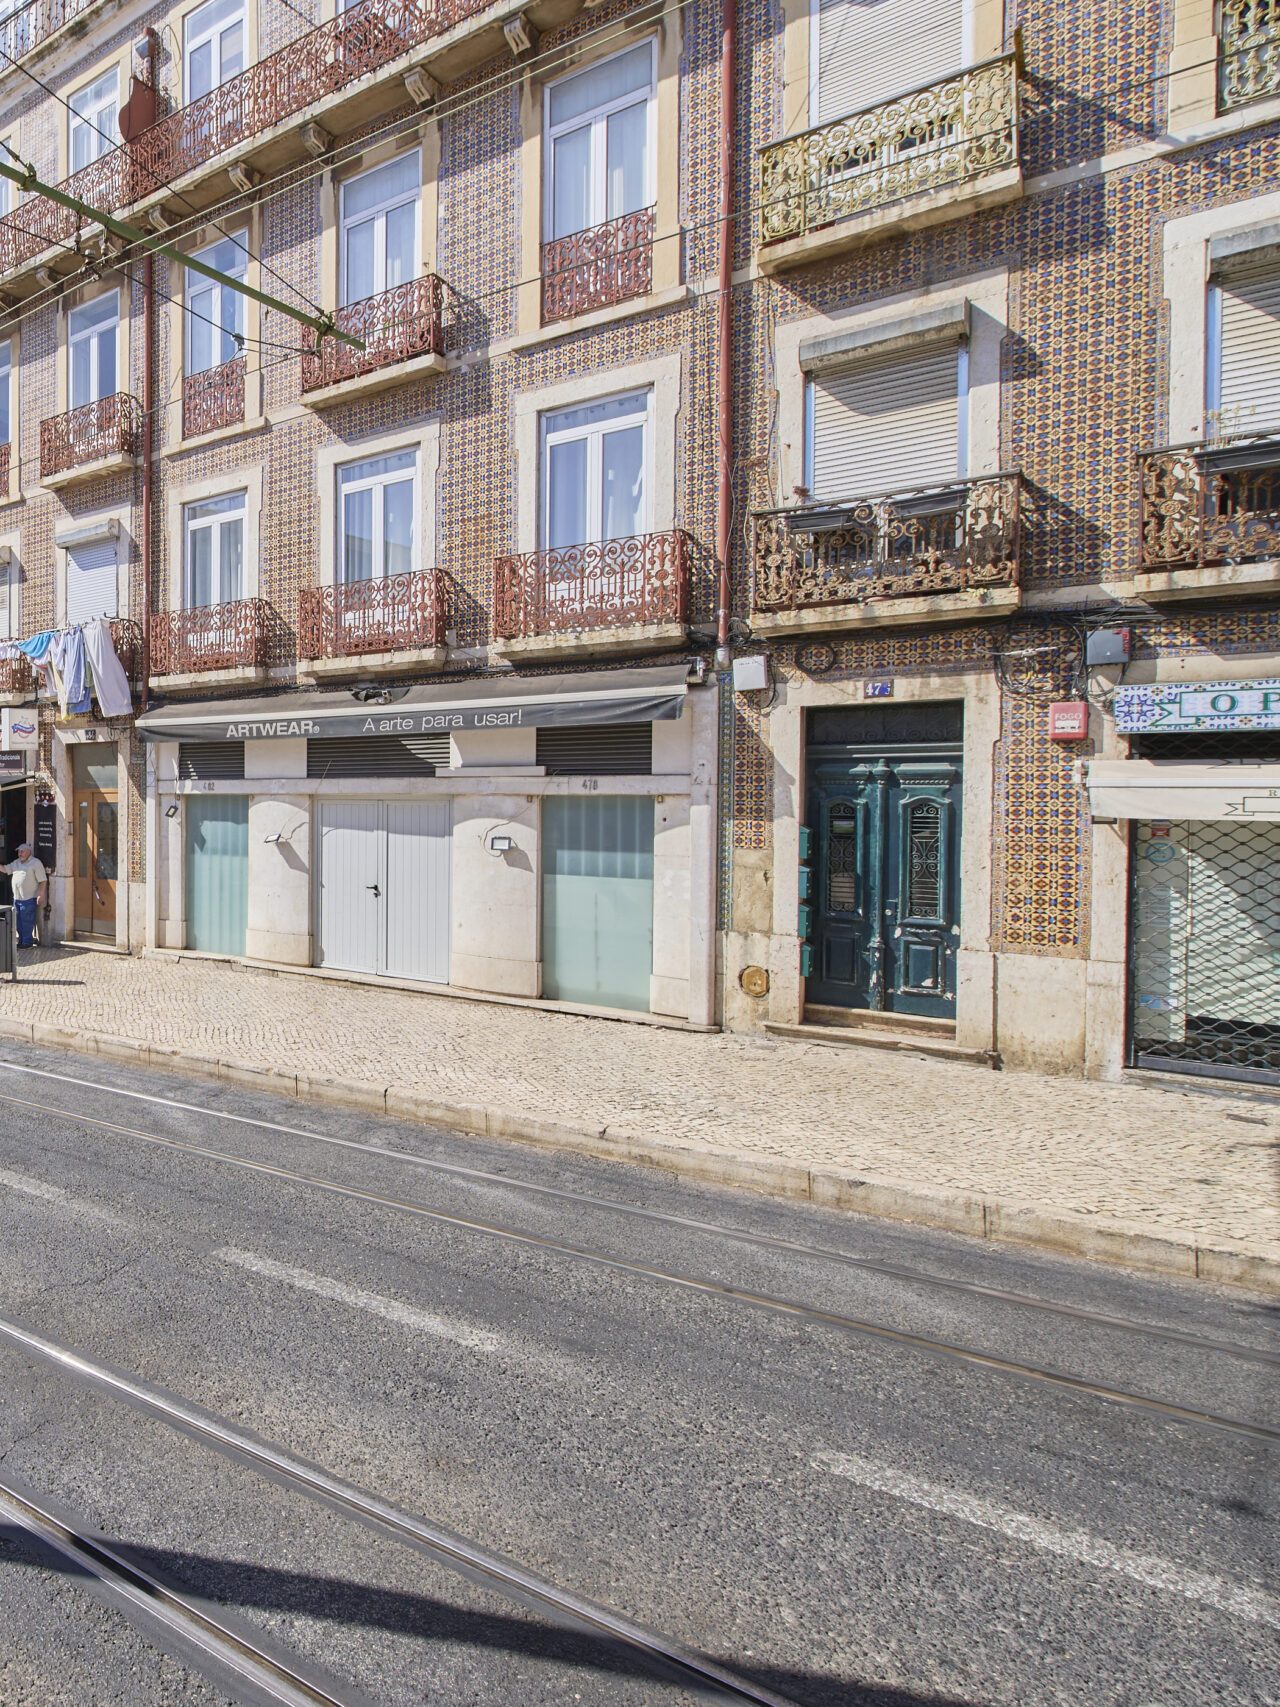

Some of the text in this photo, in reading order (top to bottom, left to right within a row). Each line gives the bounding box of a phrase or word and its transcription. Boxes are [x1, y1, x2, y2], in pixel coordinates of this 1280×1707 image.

[363, 708, 522, 732] A arte para usar!
